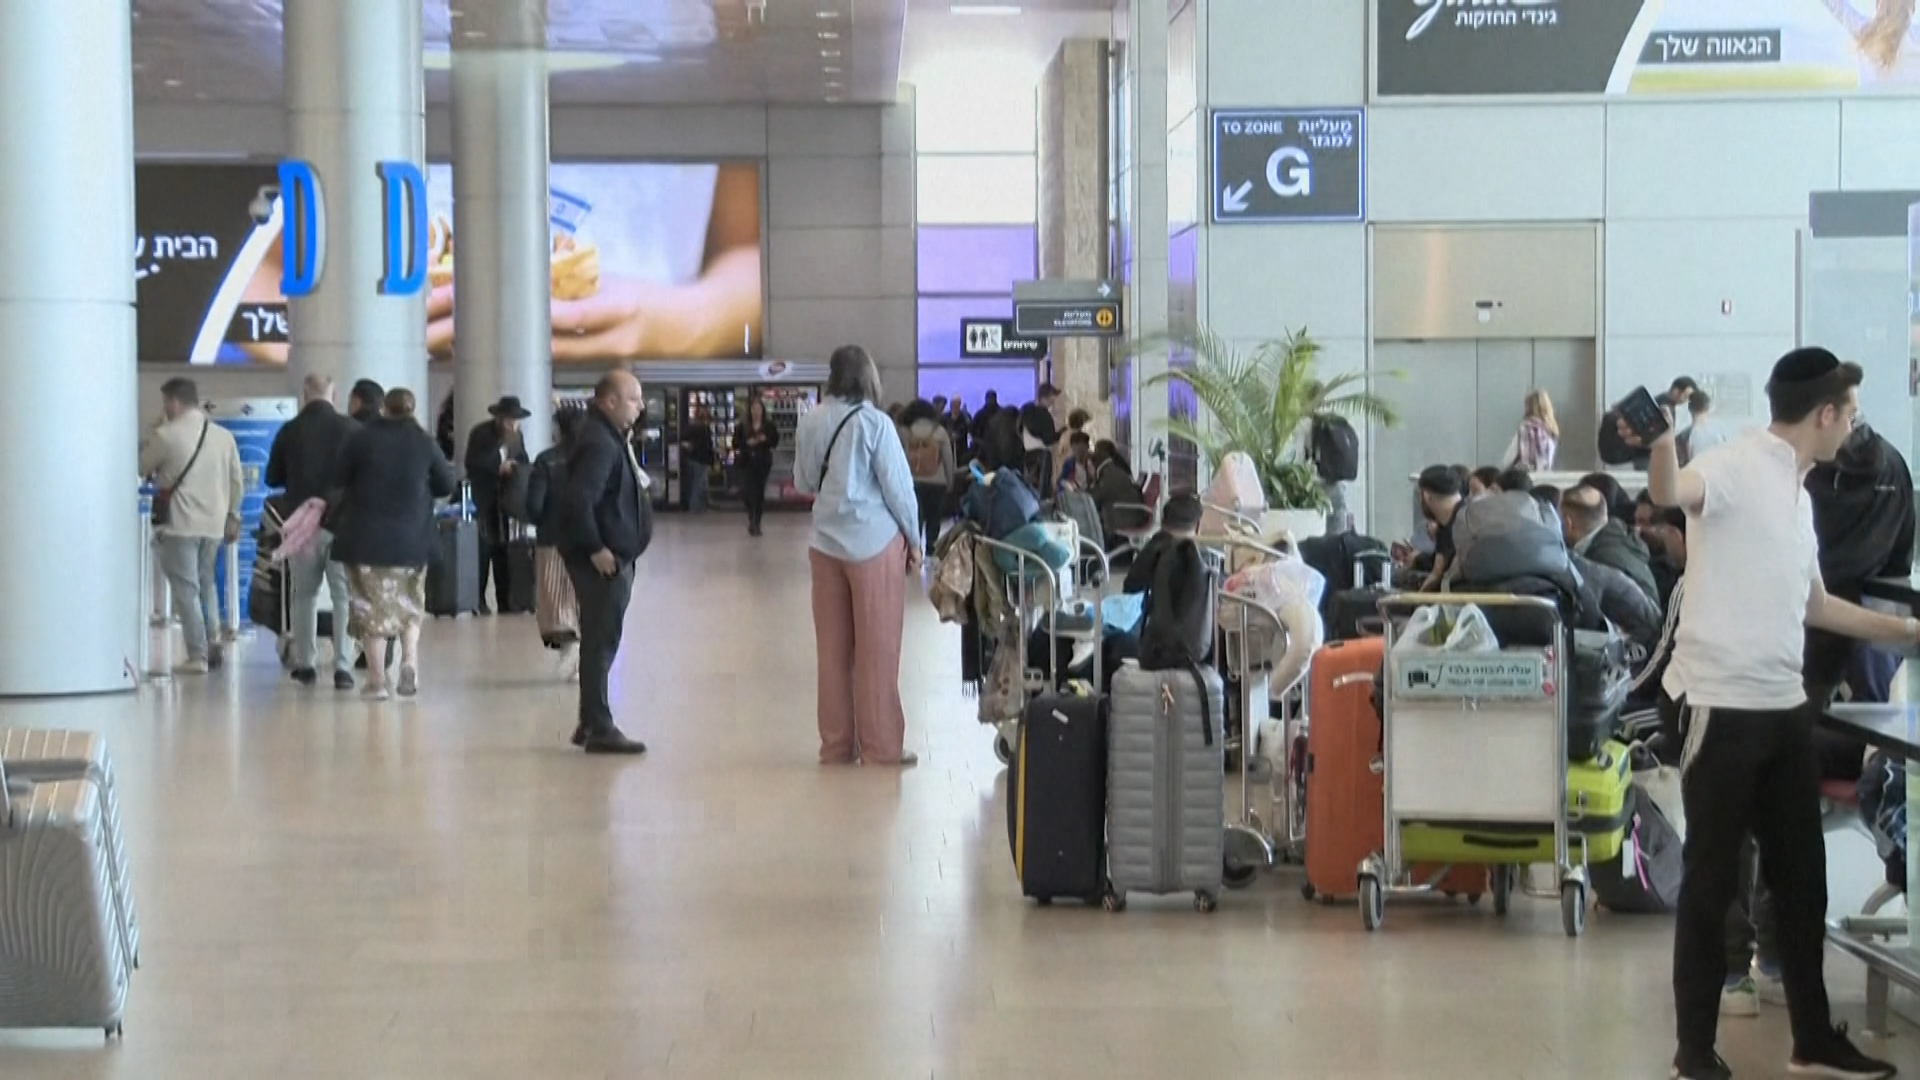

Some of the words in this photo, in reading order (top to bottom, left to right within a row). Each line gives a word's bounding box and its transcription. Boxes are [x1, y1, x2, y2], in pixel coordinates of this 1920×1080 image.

[1521, 9, 1557, 25] גינדי
[1654, 33, 1699, 62] שלך
[1705, 35, 1771, 56] הגאווה
[1221, 120, 1242, 134] TO
[1244, 120, 1284, 134] ZONE
[1297, 118, 1352, 134] מעליות
[1308, 133, 1352, 147] למגזר
[1265, 145, 1311, 197] G
[278, 159, 327, 296] D
[376, 160, 427, 297] D
[152, 235, 219, 259] הבית
